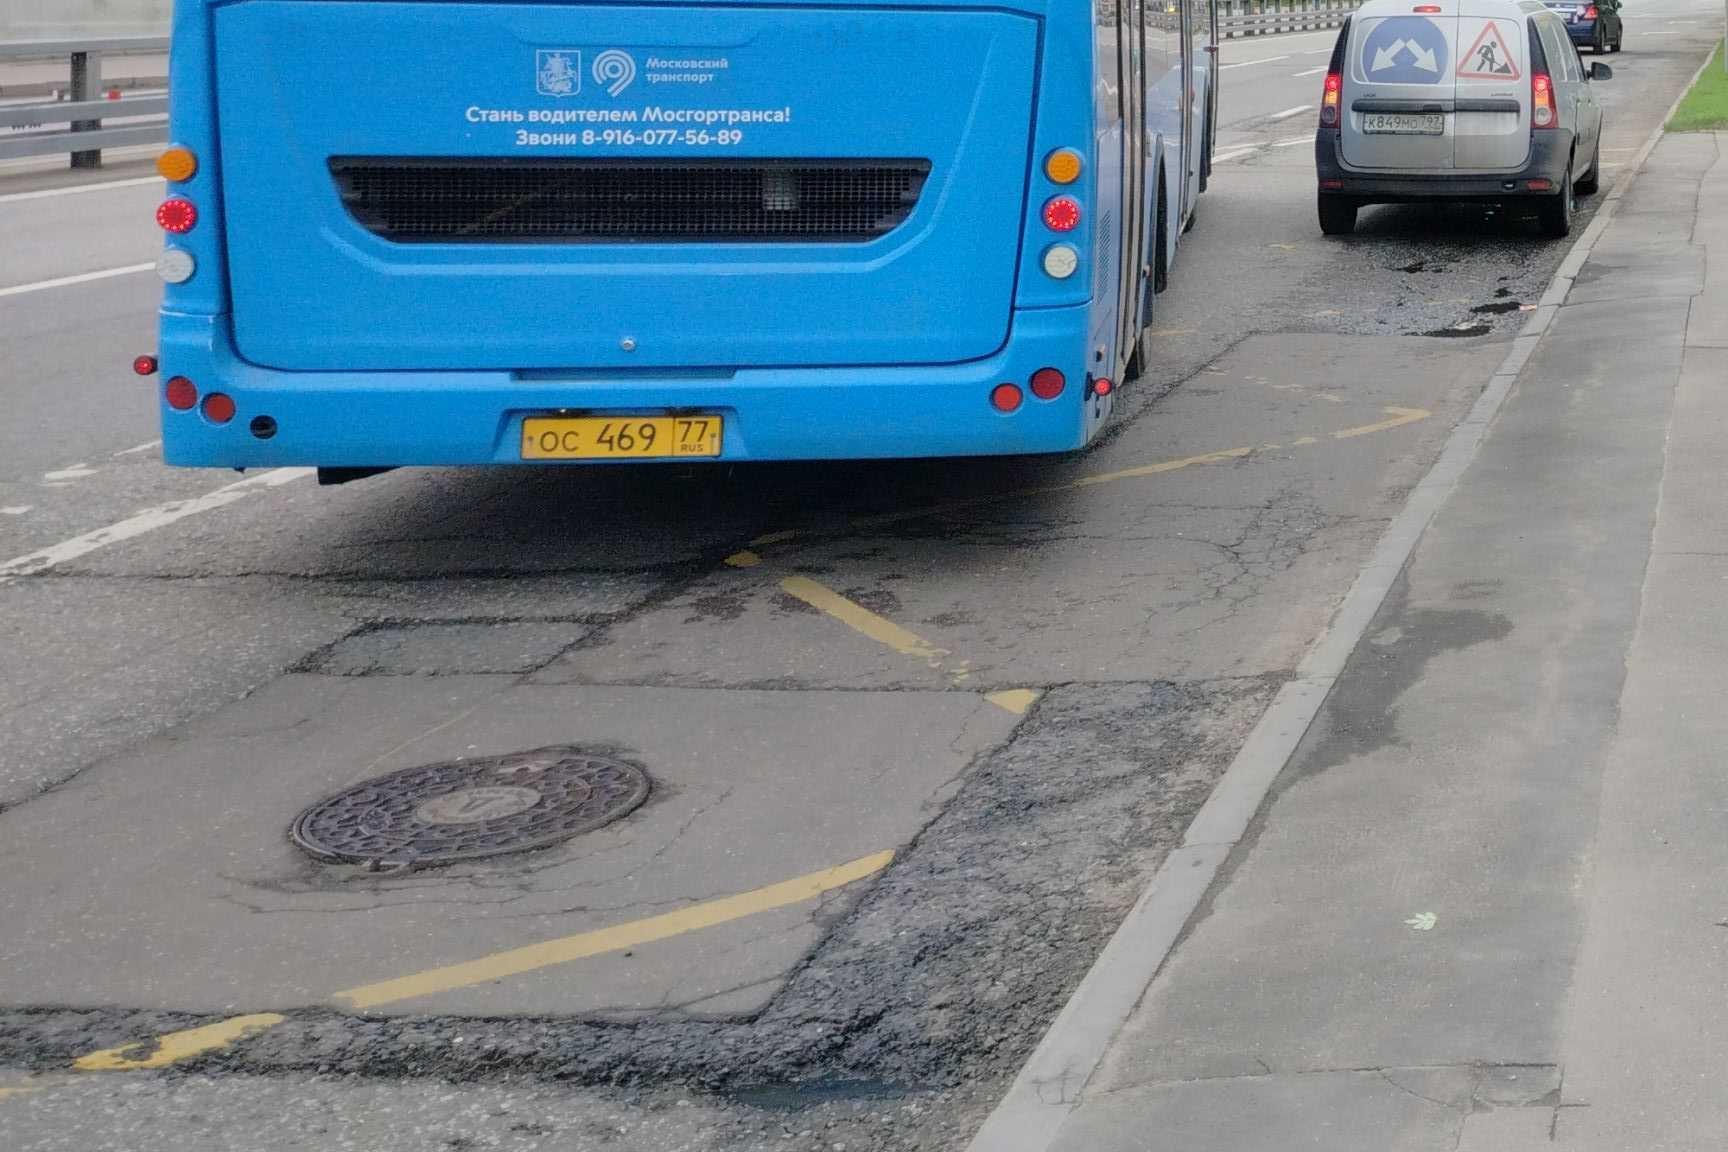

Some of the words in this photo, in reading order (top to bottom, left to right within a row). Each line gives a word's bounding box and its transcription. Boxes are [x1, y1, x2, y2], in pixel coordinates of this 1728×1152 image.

[645, 56, 729, 70] Московский
[645, 72, 714, 84] транспорт
[465, 106, 524, 123] Стань
[528, 108, 638, 125] водителем
[642, 106, 791, 125] Мосгортранса!
[515, 128, 577, 146] Звони
[581, 128, 743, 146] 8-916-077-56-89
[596, 423, 657, 452] 469
[677, 420, 709, 443] 77
[680, 443, 704, 453] RUS
